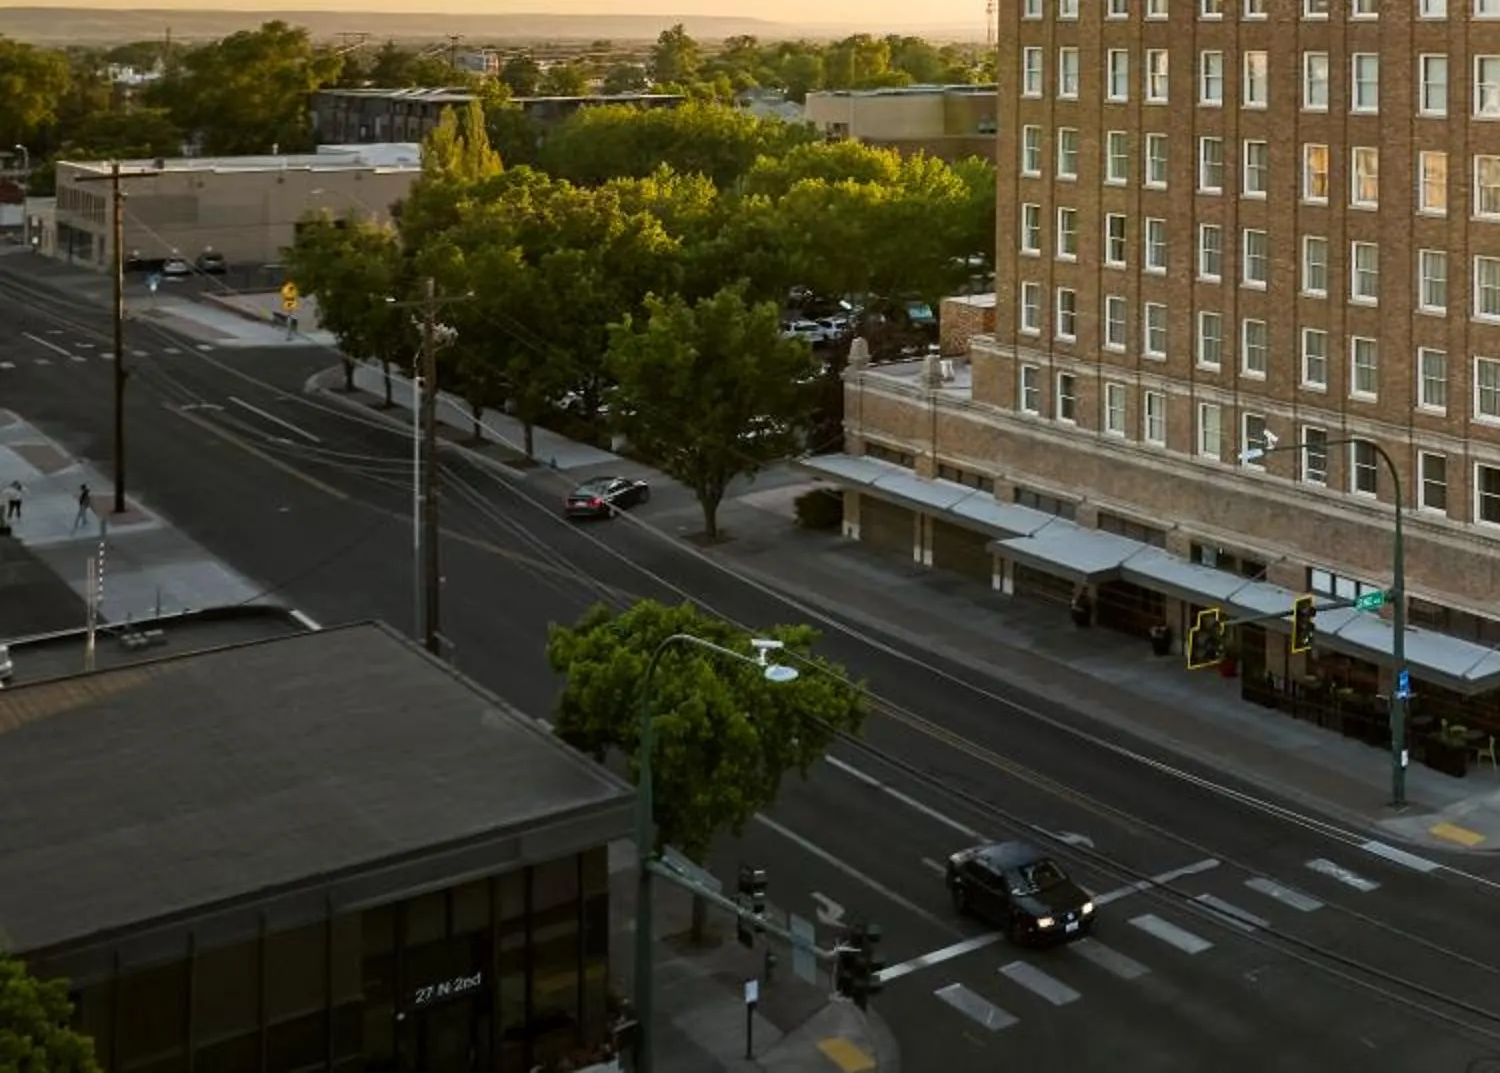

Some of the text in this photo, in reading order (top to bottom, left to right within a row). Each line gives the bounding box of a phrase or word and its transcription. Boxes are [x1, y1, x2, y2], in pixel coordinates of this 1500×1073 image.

[415, 972, 482, 1004] 27 N 2nd
